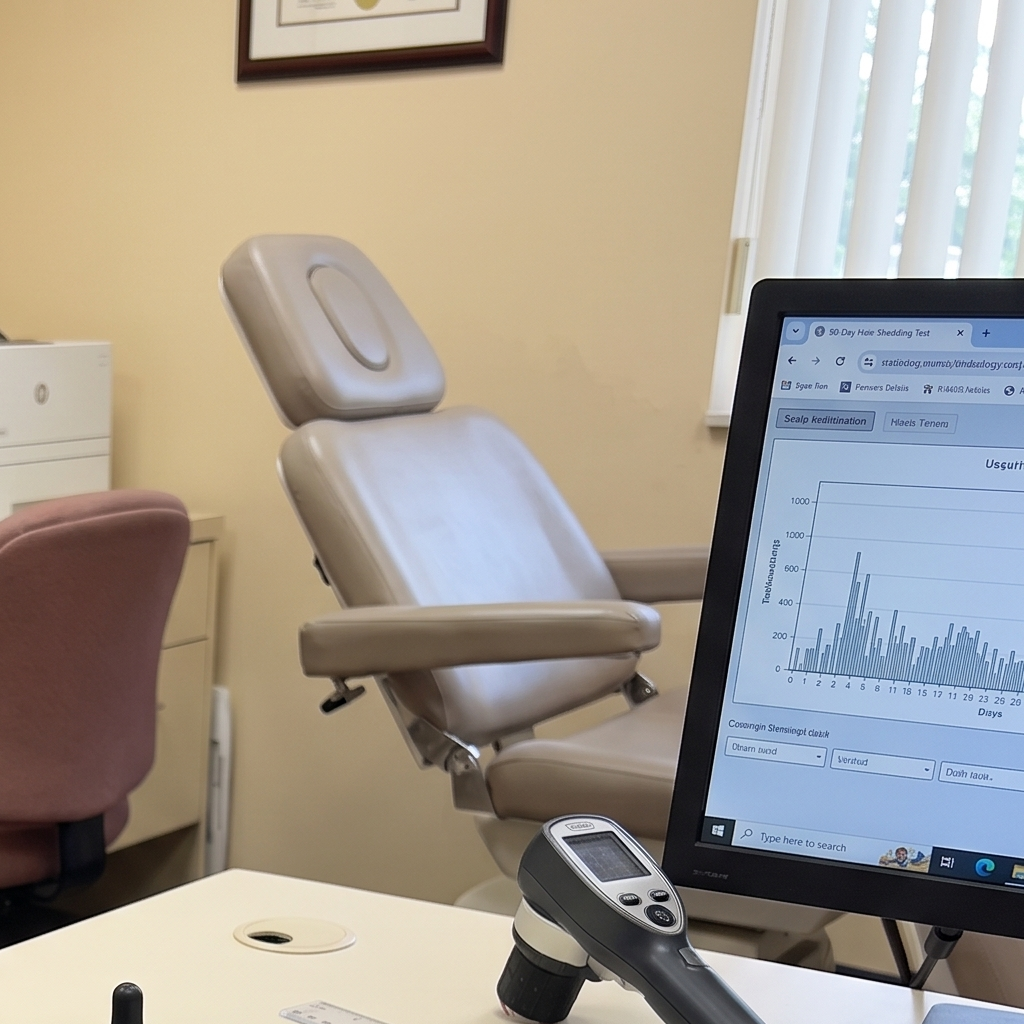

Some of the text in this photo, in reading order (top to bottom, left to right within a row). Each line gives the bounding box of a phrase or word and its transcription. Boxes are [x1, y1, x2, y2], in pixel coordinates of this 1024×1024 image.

[876, 328, 913, 339] Shedding
[915, 329, 931, 338] Test
[778, 599, 794, 607] 400
[772, 632, 788, 640] 200
[775, 665, 781, 673] 0
[760, 831, 847, 853] Type here to search
